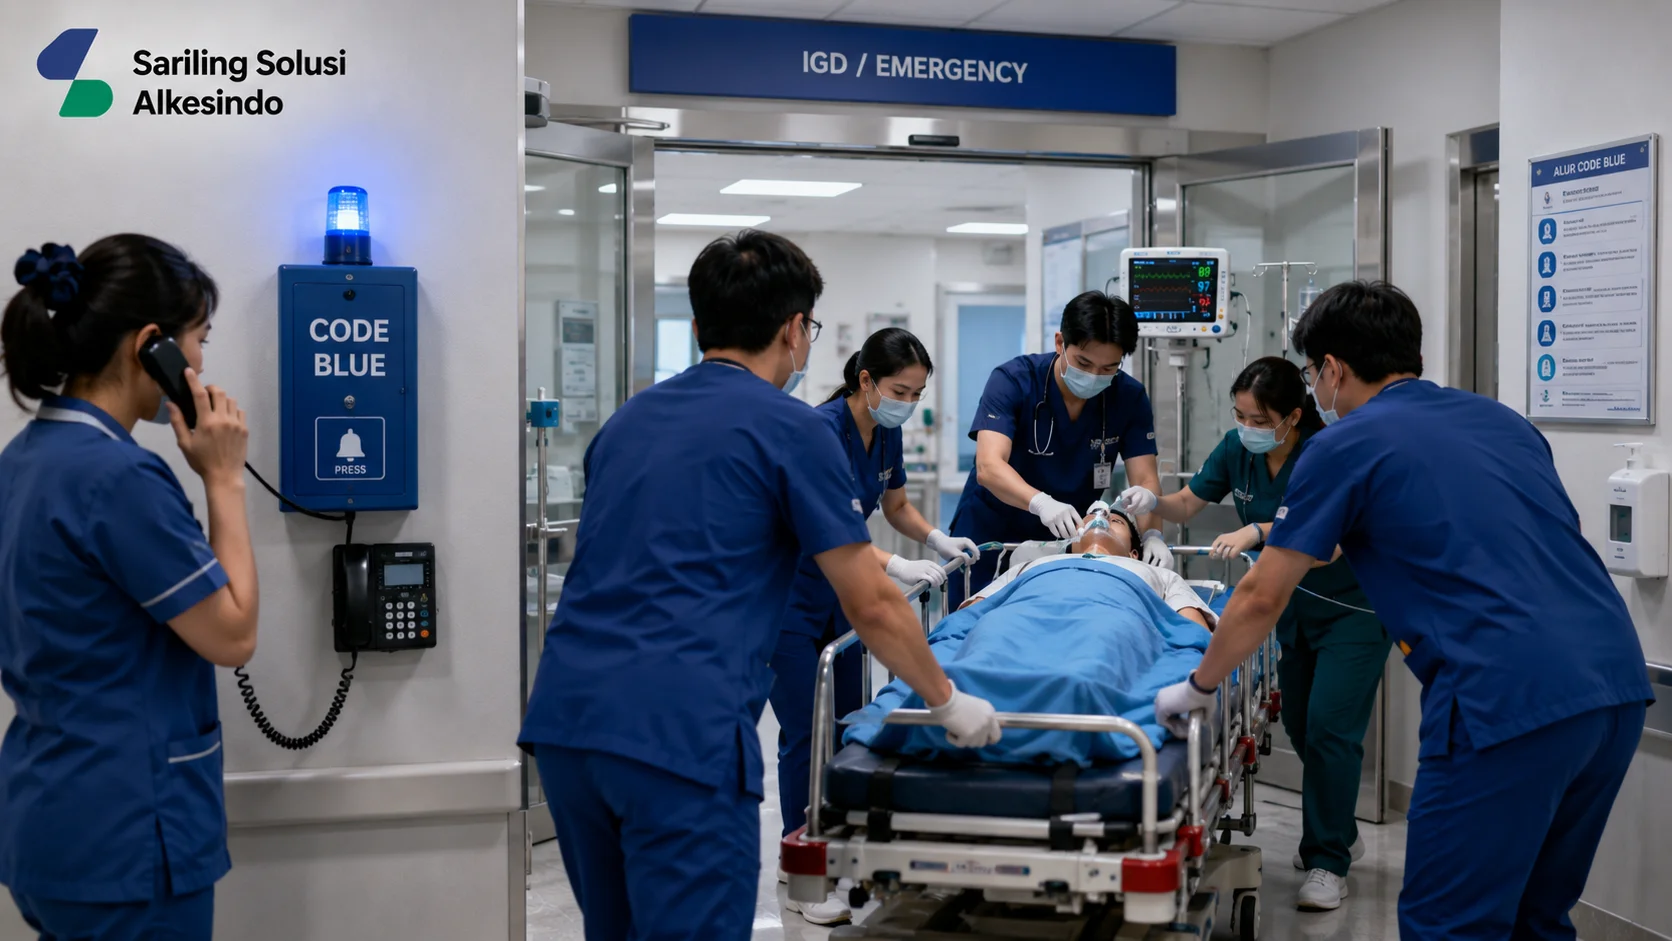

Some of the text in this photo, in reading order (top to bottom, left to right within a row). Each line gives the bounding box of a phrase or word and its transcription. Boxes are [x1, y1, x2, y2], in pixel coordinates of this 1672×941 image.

[802, 50, 1028, 83] IGD / EMERGENCY
[1553, 153, 1626, 177] ALUR CODE BLUE
[1197, 281, 1210, 292] 97
[309, 318, 389, 342] CODE
[314, 353, 386, 377] BLUE
[334, 464, 367, 475] PRESS
